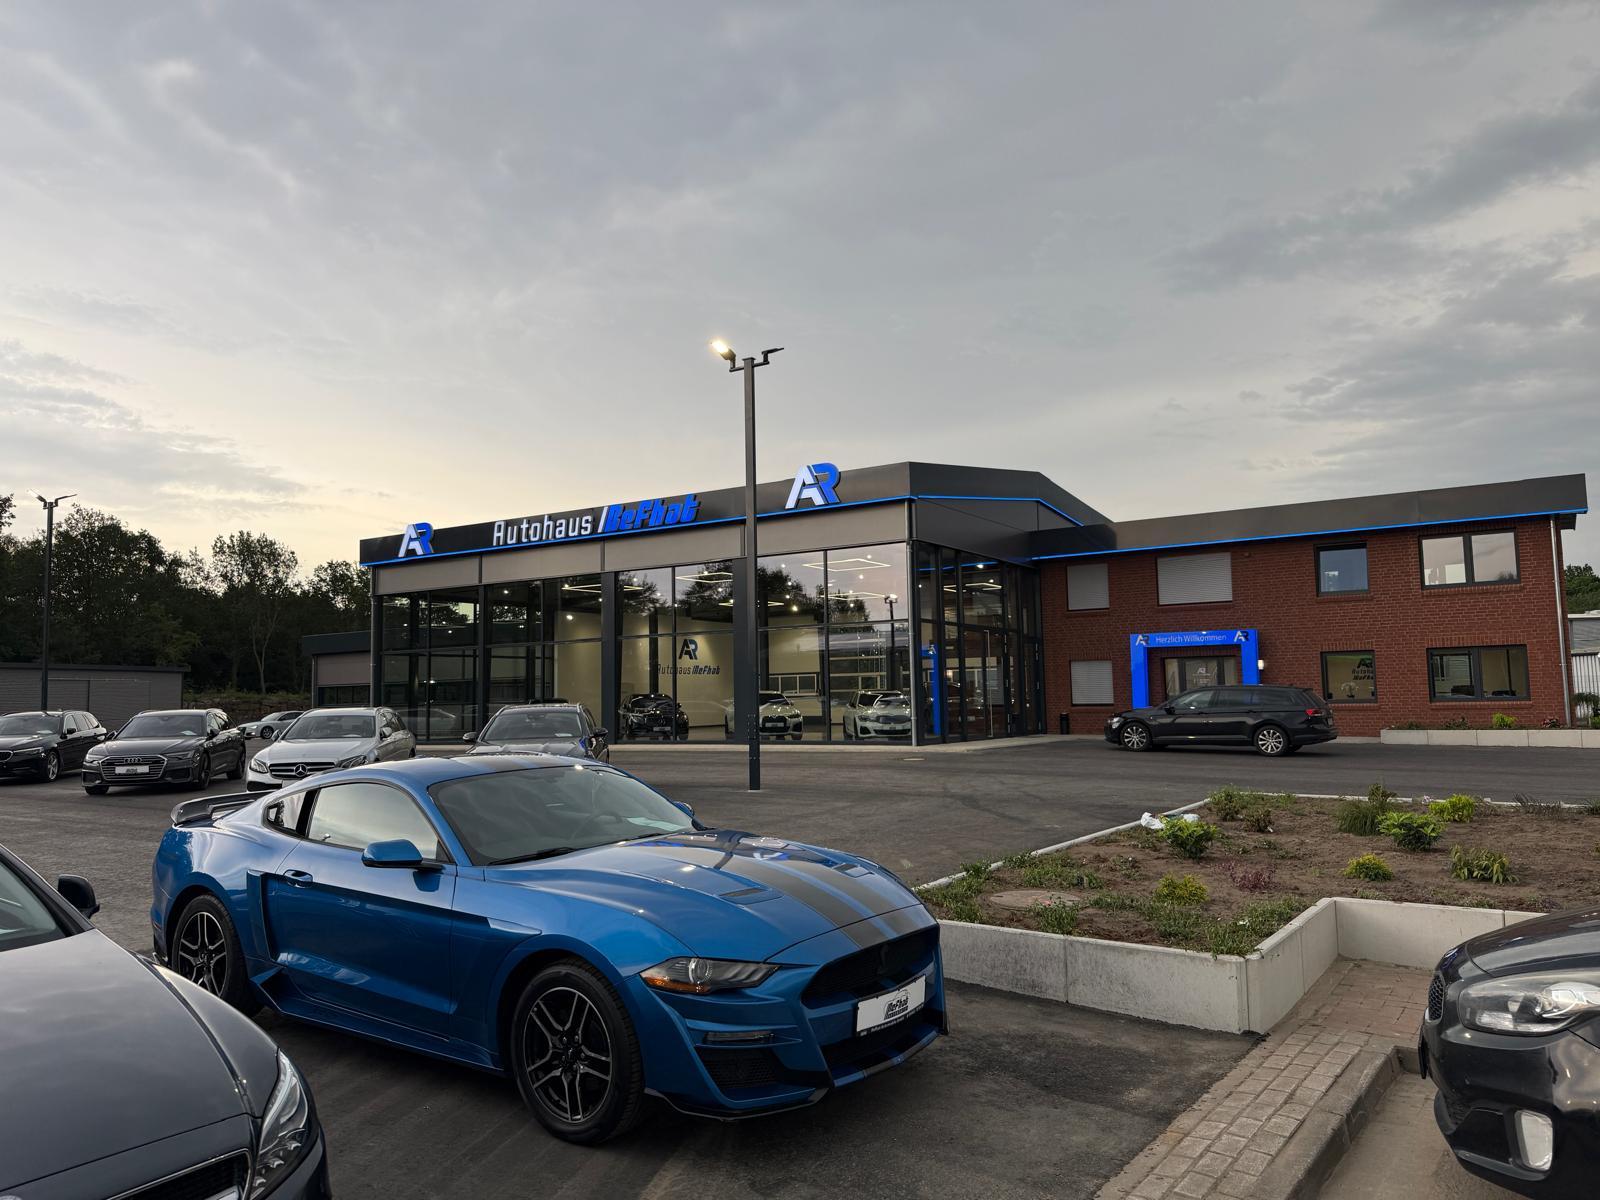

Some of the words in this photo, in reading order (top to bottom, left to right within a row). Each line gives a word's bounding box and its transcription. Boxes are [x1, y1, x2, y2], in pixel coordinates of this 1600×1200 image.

[785, 462, 842, 510] AR
[398, 522, 434, 558] AR
[493, 514, 592, 546] Autohaus
[1155, 635, 1183, 644] Herzlich
[1183, 633, 1228, 644] Willkommen
